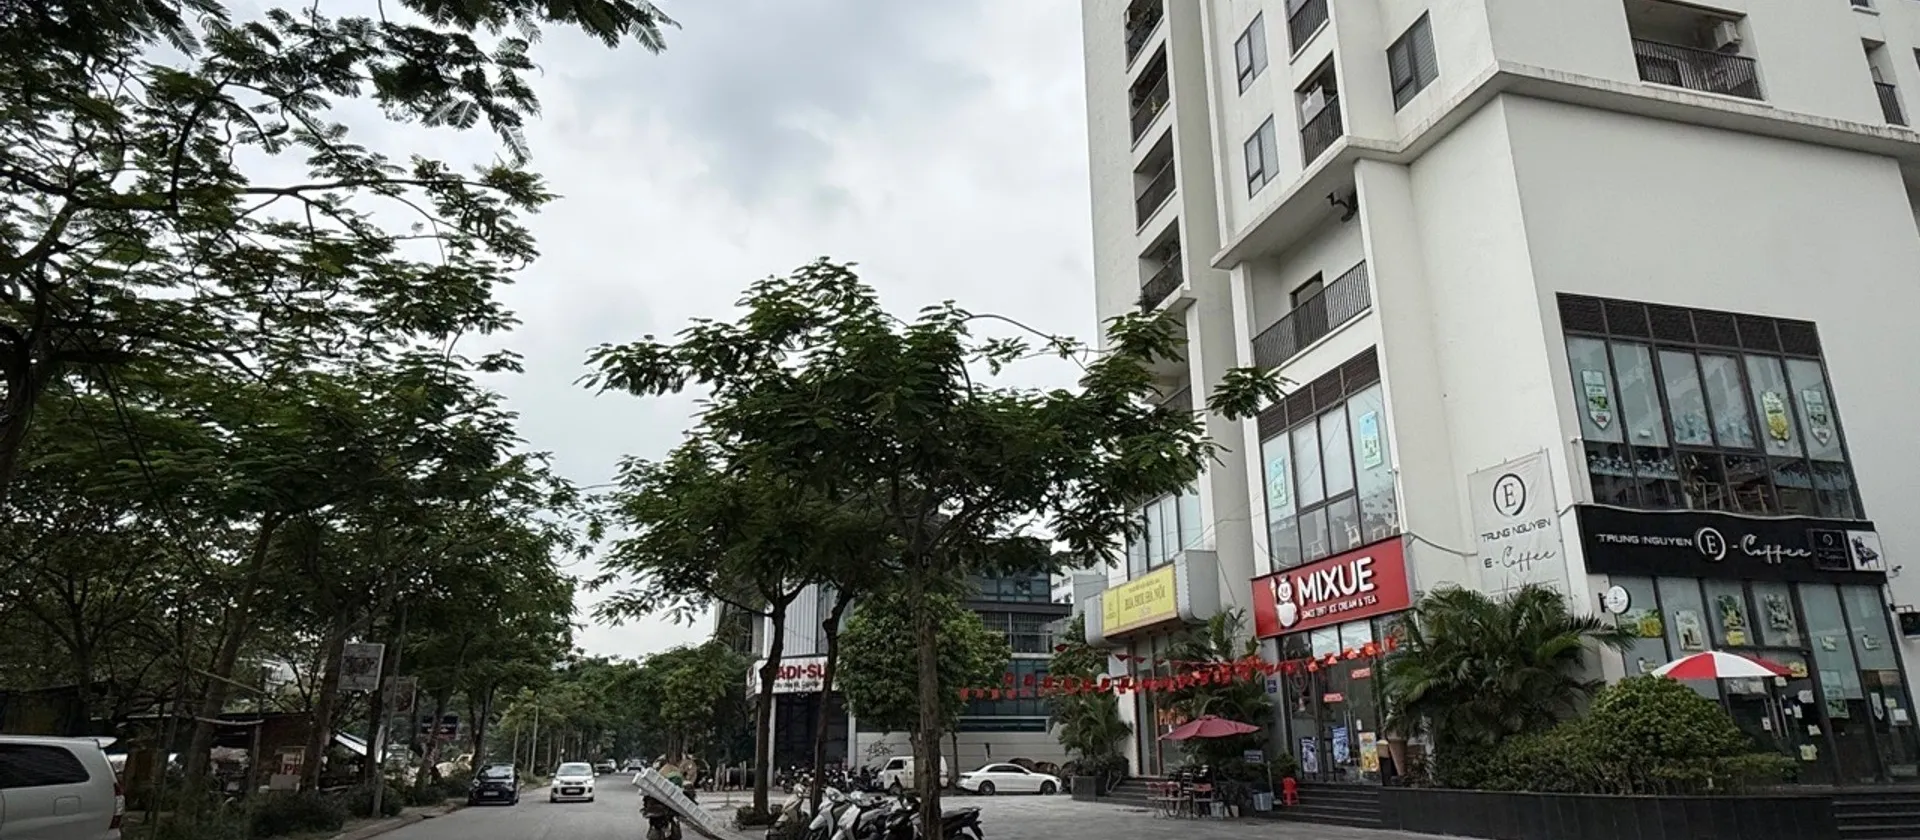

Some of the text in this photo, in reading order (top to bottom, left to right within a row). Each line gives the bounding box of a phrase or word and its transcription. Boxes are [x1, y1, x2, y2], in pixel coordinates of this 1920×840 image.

[1503, 483, 1516, 508] E
[1481, 528, 1511, 542] TRUNG
[1595, 533, 1639, 544] TRUNG
[1641, 535, 1692, 547] NGUYEN
[1297, 556, 1375, 606] MIXUE
[1338, 599, 1357, 612] CREAM
[1364, 595, 1377, 606] TEA
